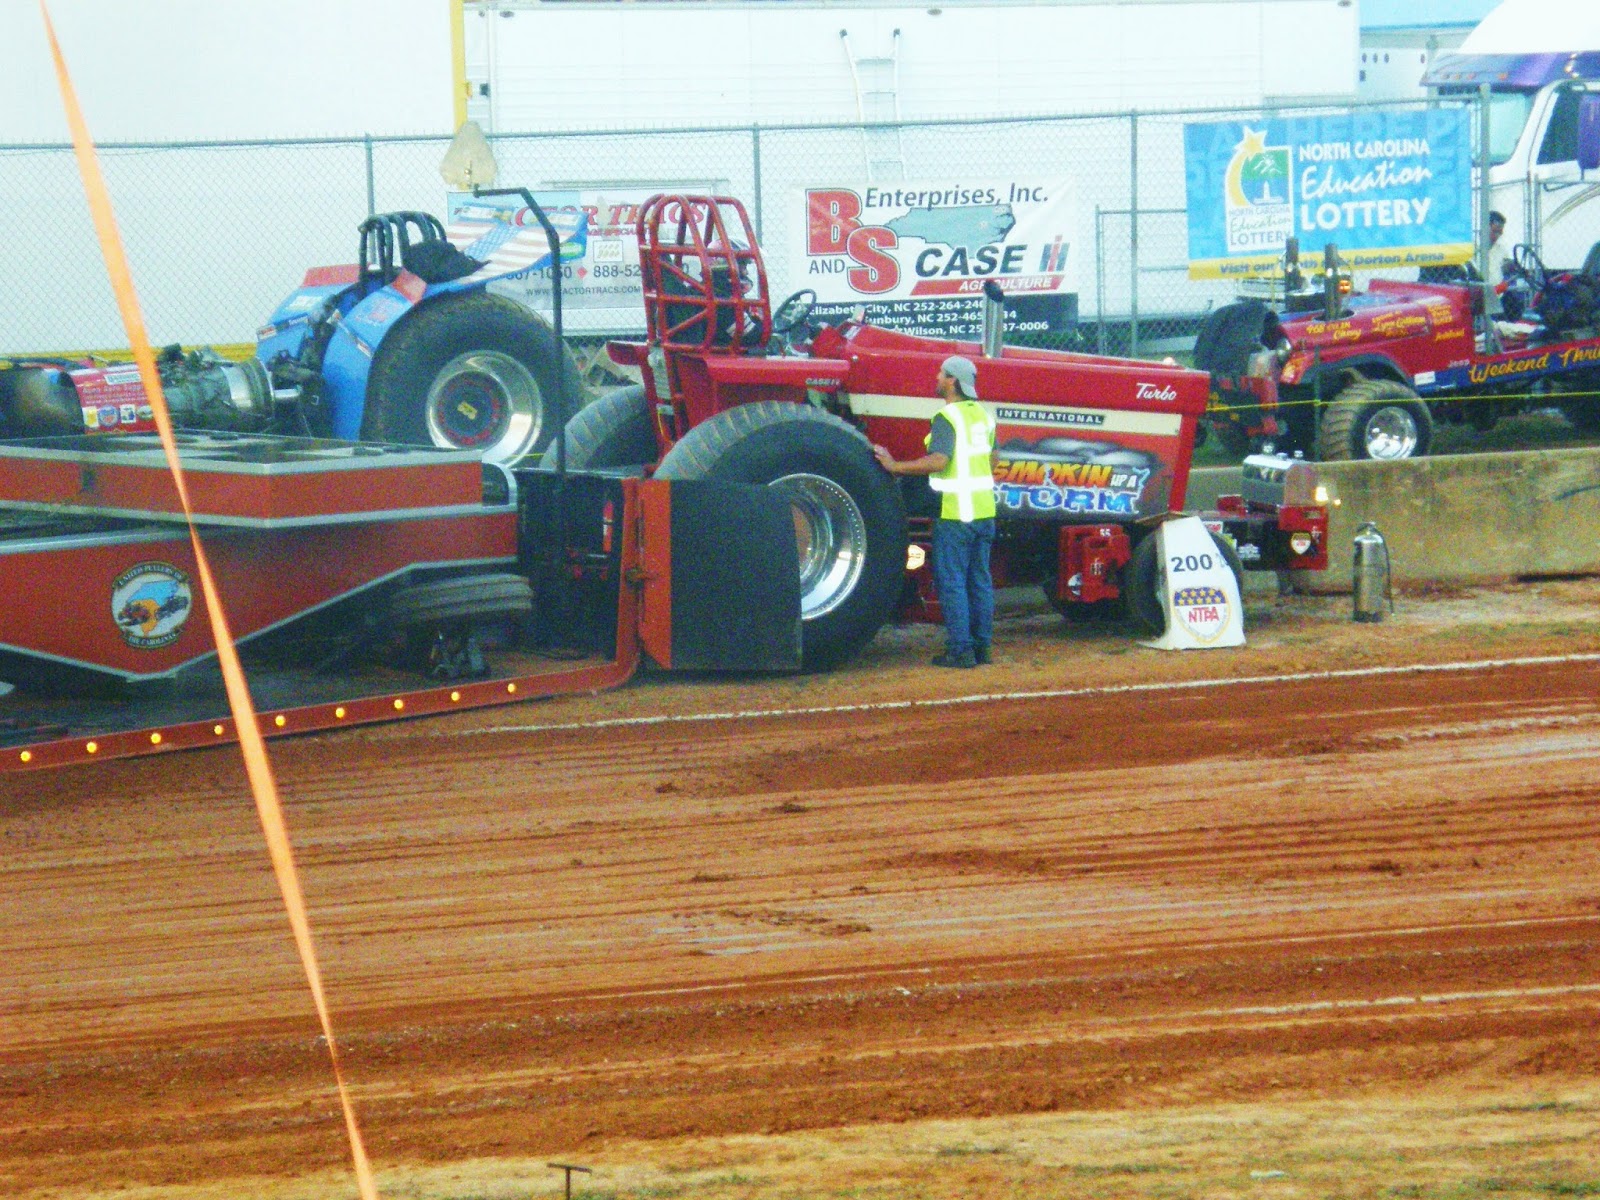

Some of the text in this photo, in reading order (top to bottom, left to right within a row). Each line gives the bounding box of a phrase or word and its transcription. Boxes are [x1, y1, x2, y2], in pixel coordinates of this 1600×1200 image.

[1300, 138, 1431, 162] NORTH CAROLINA
[1301, 162, 1433, 200] Education
[865, 183, 1049, 211] Enterprises, Inc.
[1302, 197, 1431, 231] LOTTERY
[805, 188, 900, 294] B AND S
[915, 244, 1028, 277] CASE
[810, 304, 861, 317] Elizabet
[894, 303, 911, 312] NC
[918, 313, 934, 323] NC
[904, 325, 947, 336] Wilson,
[950, 325, 966, 334] NC
[1469, 352, 1550, 385] Weekend
[1136, 382, 1177, 401] Turbo
[999, 409, 1102, 424] INTERNATIONAL
[993, 460, 1113, 488] SMOKIN
[1110, 474, 1126, 488] UP
[993, 483, 1139, 513] TORM
[1171, 553, 1213, 572] 200
[1188, 606, 1220, 623] NTPA
